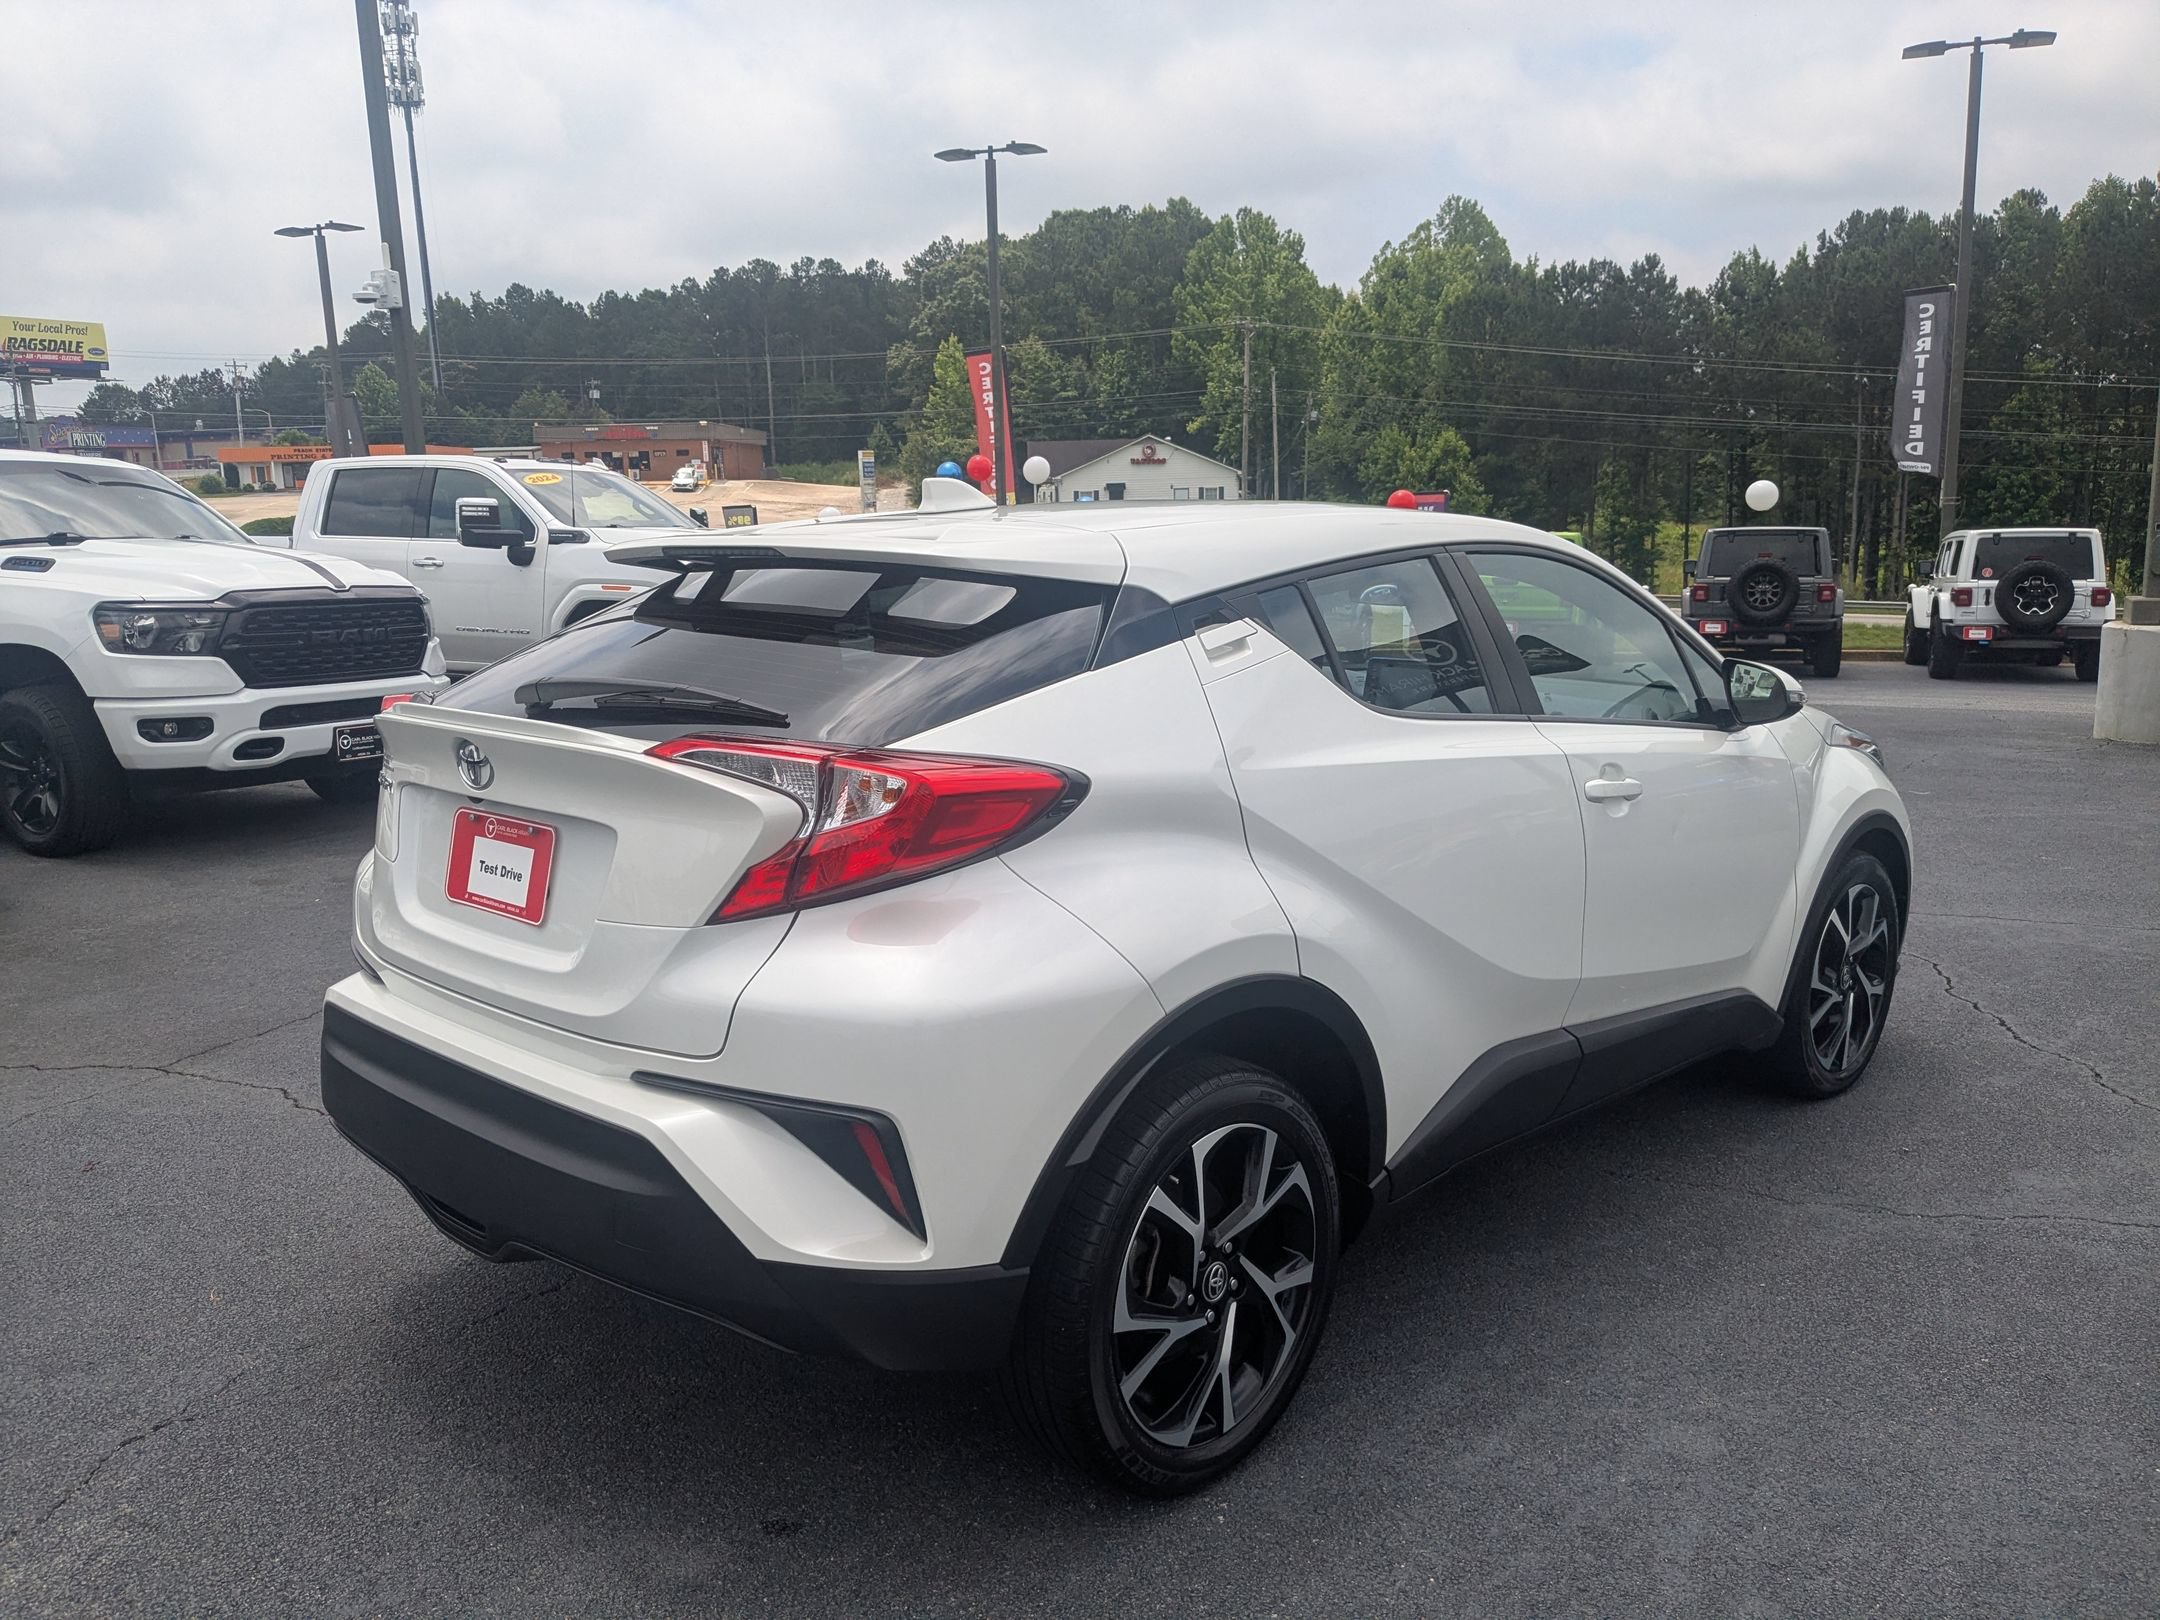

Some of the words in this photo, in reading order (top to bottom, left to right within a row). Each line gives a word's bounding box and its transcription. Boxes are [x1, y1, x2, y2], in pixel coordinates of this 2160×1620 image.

[12, 320, 36, 332] Your
[38, 323, 63, 334] Local
[65, 324, 88, 336] Pros!
[7, 336, 84, 354] RAGSDALE
[72, 431, 106, 448] PRINTING
[528, 474, 560, 484] 2024
[456, 625, 507, 634] DENALI
[479, 859, 498, 876] Test
[500, 865, 523, 882] Drive
